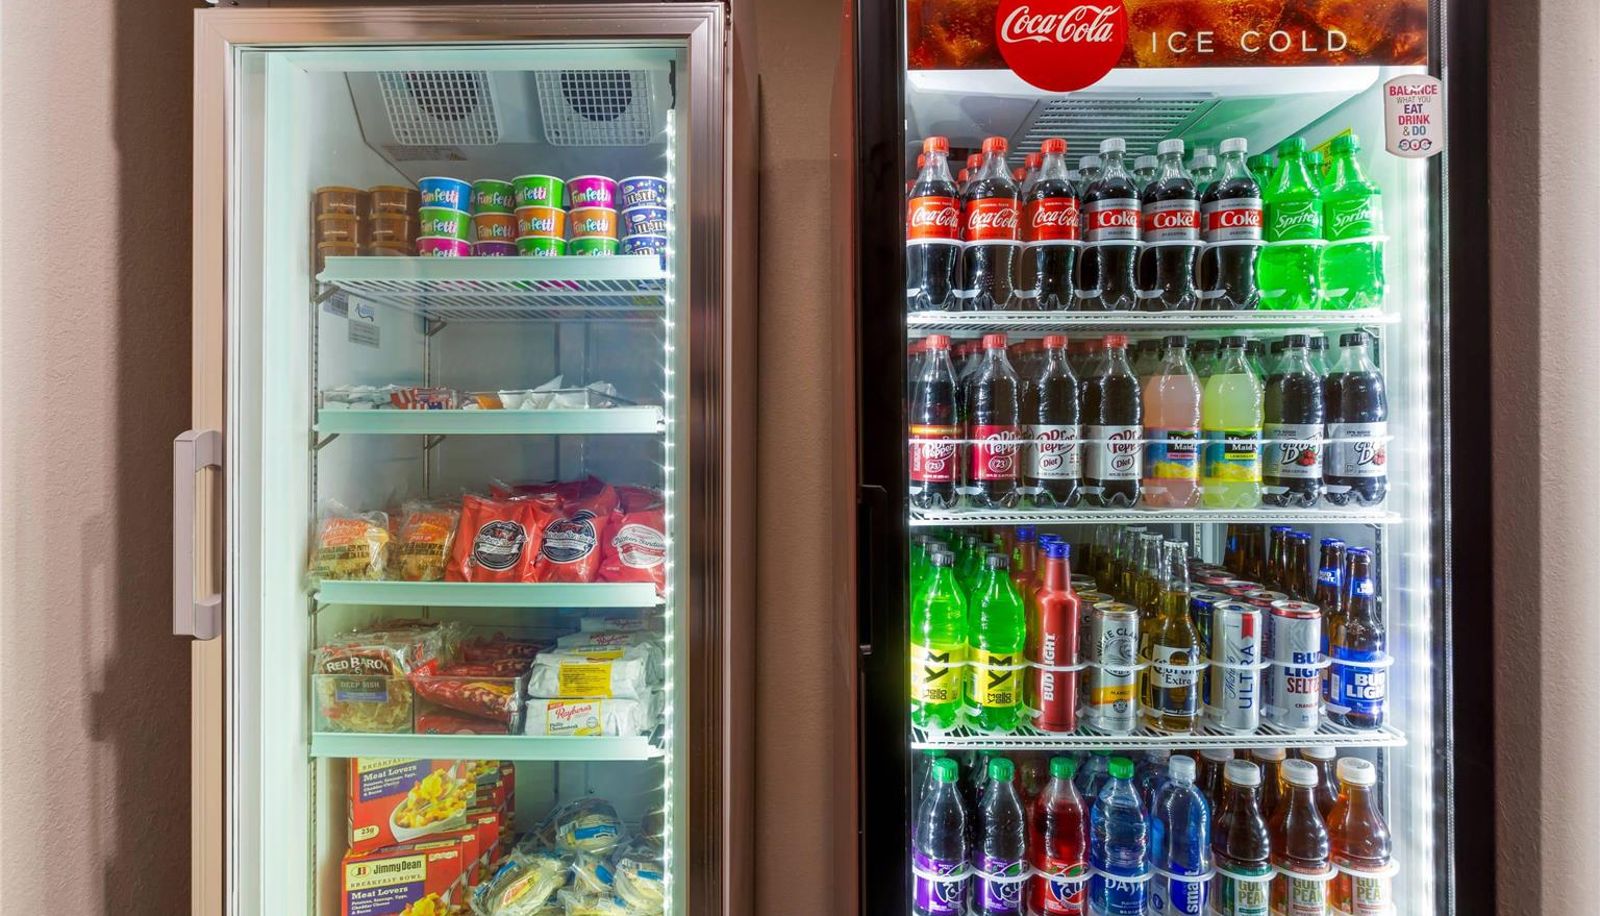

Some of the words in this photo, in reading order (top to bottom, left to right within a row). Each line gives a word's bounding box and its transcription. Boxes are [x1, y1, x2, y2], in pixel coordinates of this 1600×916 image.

[1001, 5, 1121, 43] Coca-Cola
[1152, 31, 1214, 53] ICE
[1240, 30, 1348, 53] COLD
[1389, 85, 1438, 96] BALANCE
[1396, 96, 1415, 104] WHAT
[1404, 104, 1423, 114] EAT
[1398, 115, 1430, 125] DRINK
[1403, 126, 1410, 136] &
[1412, 126, 1426, 136] DO
[421, 188, 459, 203] Funfetti
[572, 187, 611, 203] Funfetti
[519, 217, 555, 232] Funfetti
[912, 207, 960, 229] Coca-Cola
[969, 208, 1020, 229] Coca-Cola
[1032, 207, 1079, 228] Coca-Cola
[1101, 211, 1137, 227] Coke
[1154, 212, 1194, 228] Coke
[1220, 211, 1260, 227] Coke
[1276, 212, 1314, 228] Sprite
[1333, 208, 1371, 227] Sprit
[421, 219, 457, 233] Funfetti
[573, 218, 609, 233] Funfetti
[1231, 443, 1253, 451] Maid
[1043, 459, 1058, 468] Diet
[1116, 459, 1131, 468] Diet
[1044, 633, 1055, 671] IGHT
[1293, 652, 1316, 664] BU
[326, 660, 349, 672] RED
[1239, 644, 1254, 709] ULTRA
[1043, 672, 1054, 701] BUD
[363, 771, 386, 782] Meat
[388, 766, 417, 776] Lovers
[373, 863, 401, 874] Jimmy
[402, 860, 422, 870] Dean
[350, 877, 398, 888] BREAKFAST
[1185, 867, 1199, 913] smat
[352, 892, 376, 900] Meat
[378, 886, 408, 896] Lovers
[1239, 891, 1263, 904] PEA
[1357, 887, 1381, 900] PEA
